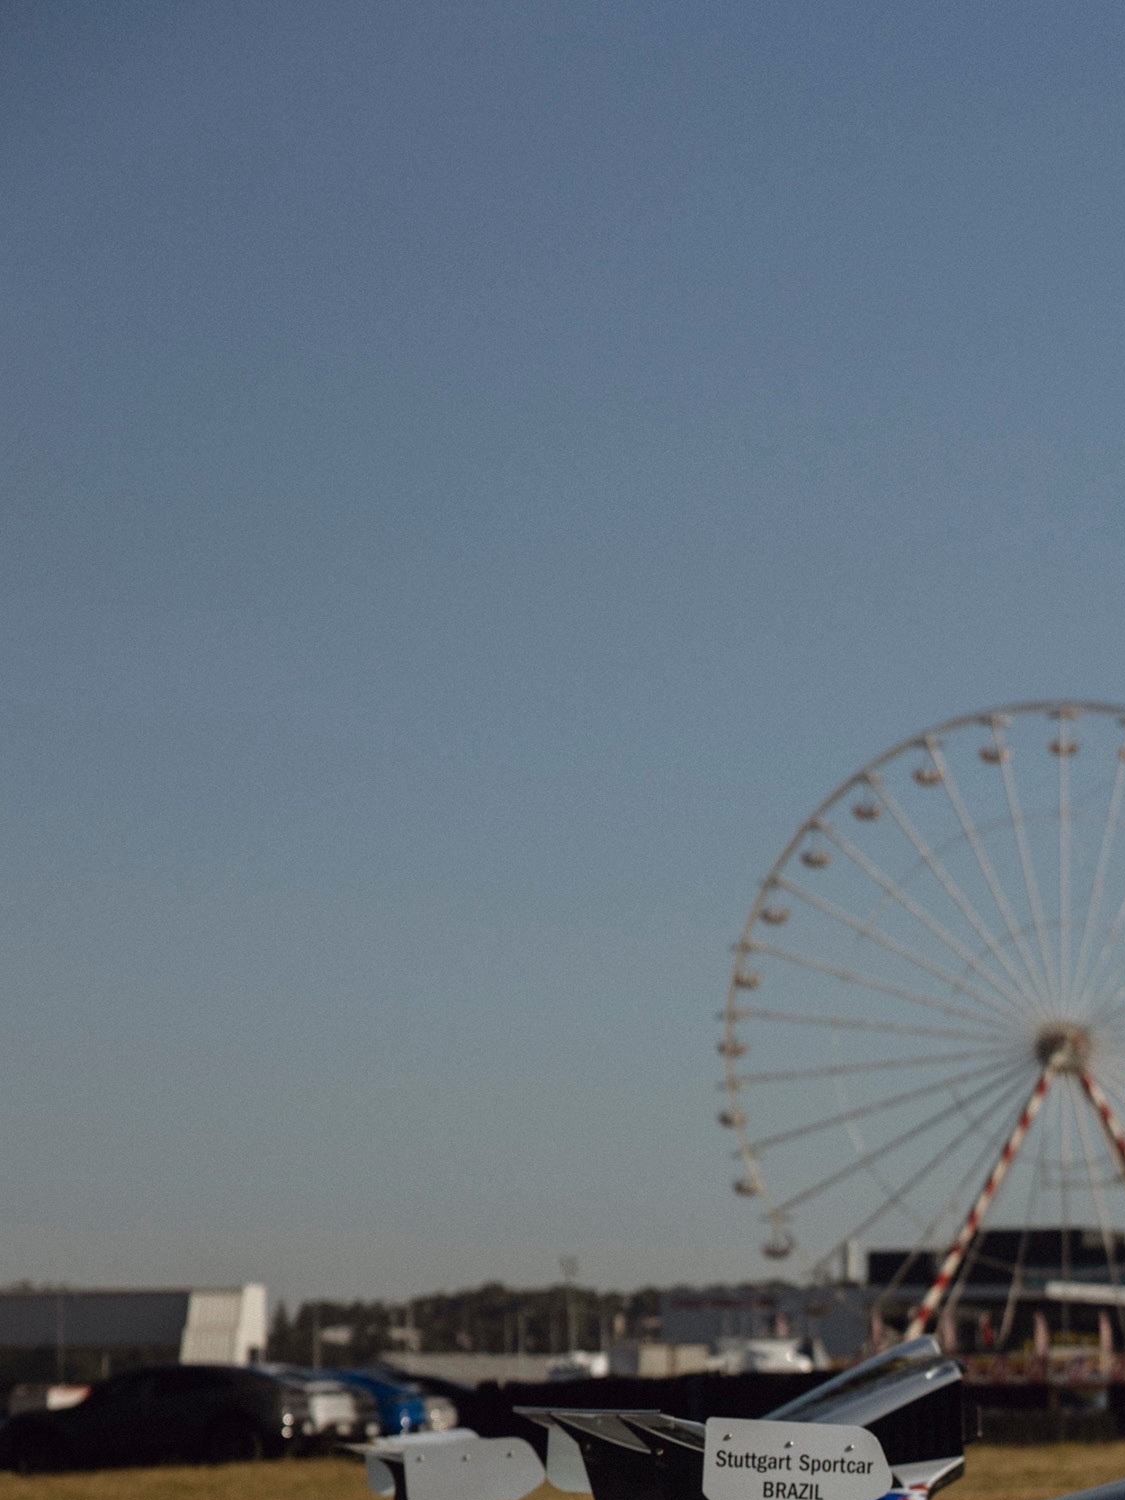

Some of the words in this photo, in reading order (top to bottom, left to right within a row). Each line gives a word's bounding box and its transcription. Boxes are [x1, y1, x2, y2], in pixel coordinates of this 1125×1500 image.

[716, 1450, 791, 1473] Stuttgart
[799, 1454, 874, 1475] Sportcar
[763, 1481, 824, 1500] BRAZIL
